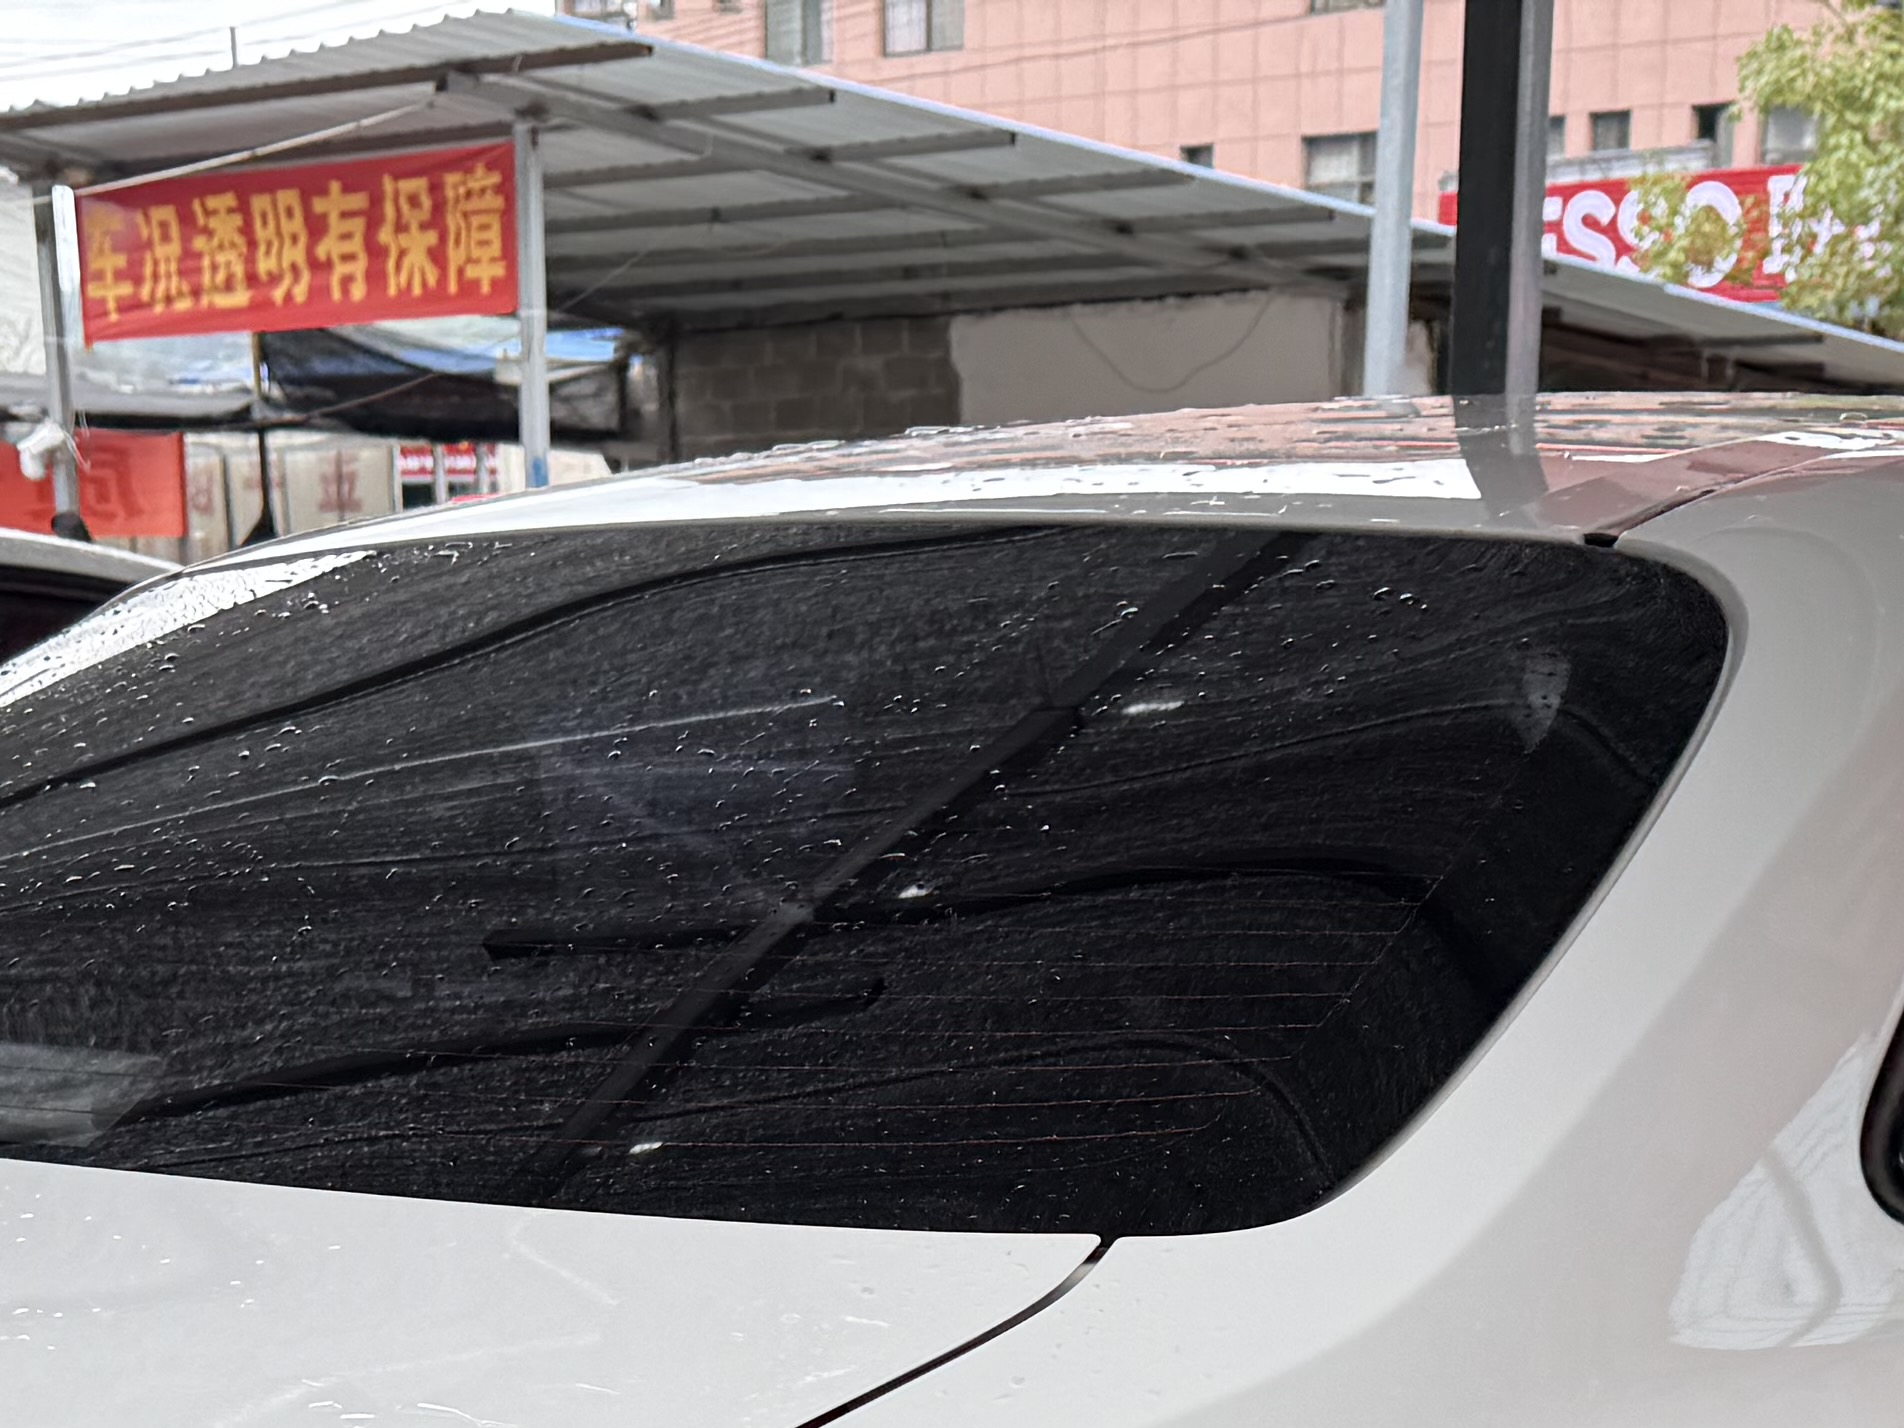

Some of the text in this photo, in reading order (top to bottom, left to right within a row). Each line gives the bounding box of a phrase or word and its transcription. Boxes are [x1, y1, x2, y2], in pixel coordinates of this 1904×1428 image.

[85, 163, 506, 321] 车况透明有保障
